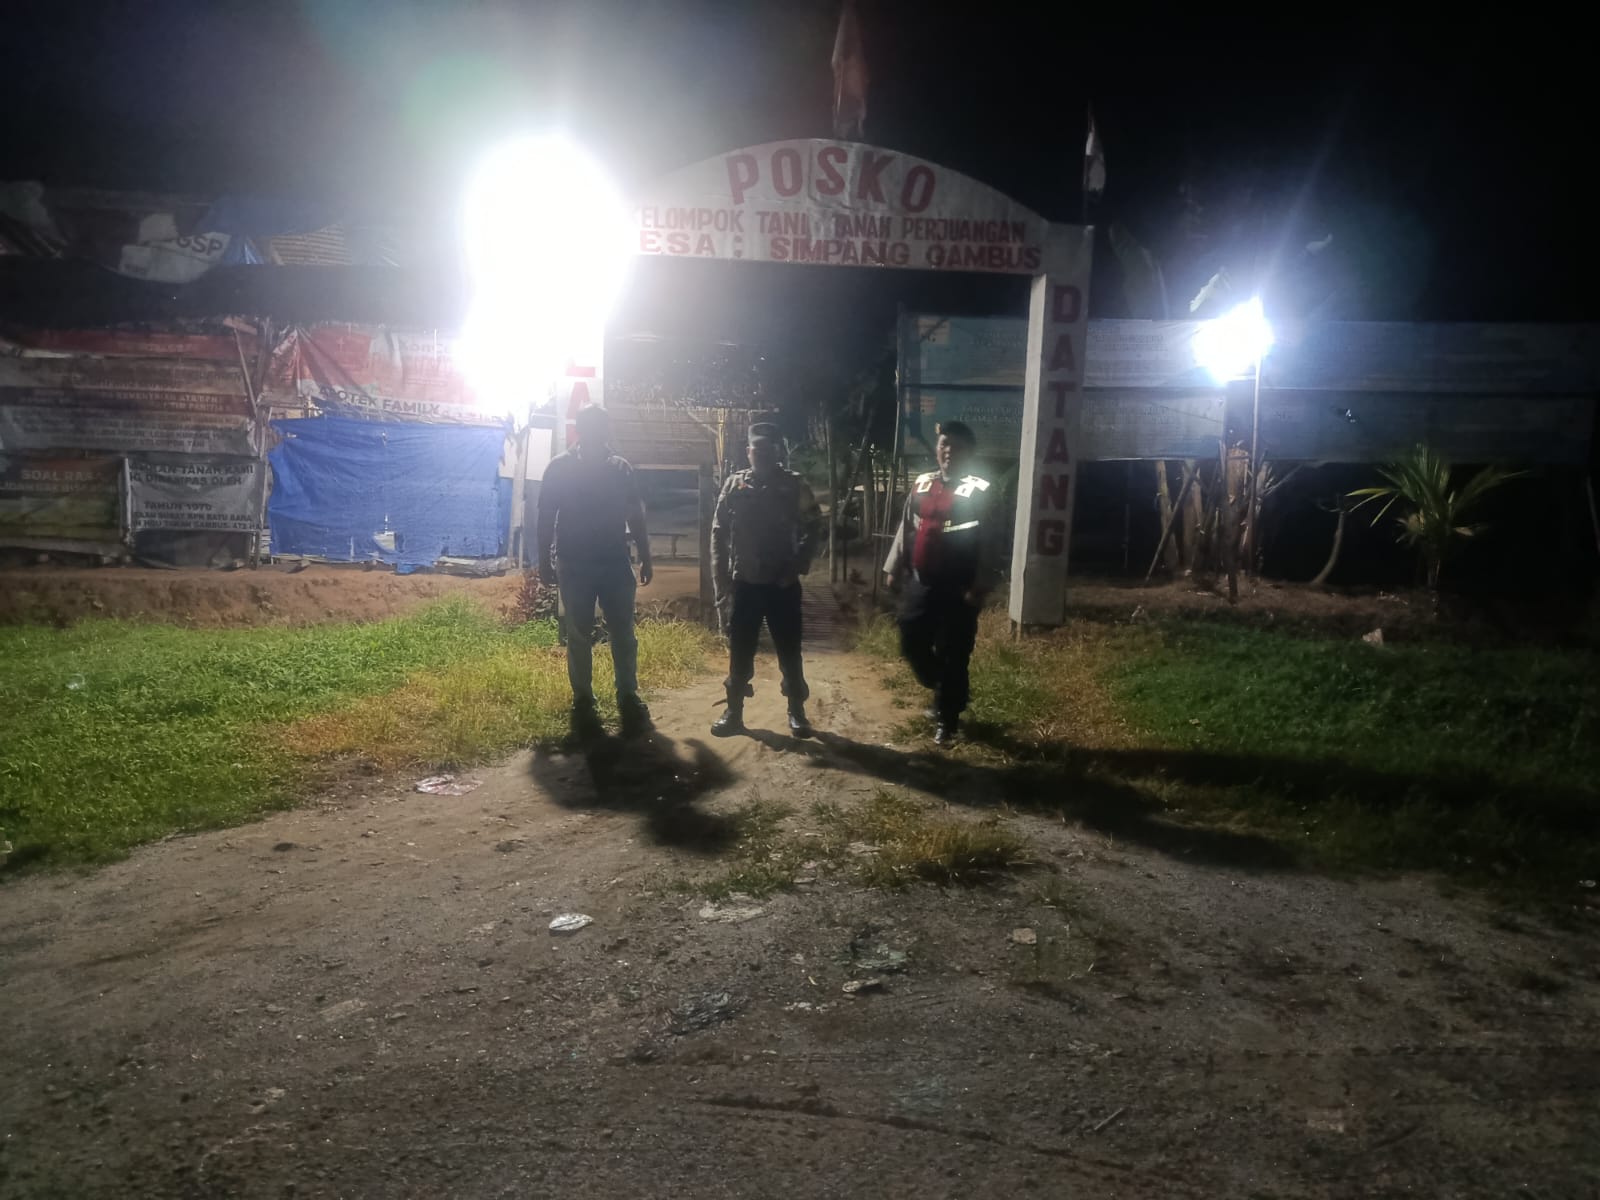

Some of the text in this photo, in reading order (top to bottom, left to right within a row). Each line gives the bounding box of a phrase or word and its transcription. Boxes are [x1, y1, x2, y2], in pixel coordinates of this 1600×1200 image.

[726, 147, 936, 213] POSKO
[638, 205, 744, 233] ELOMPOK
[756, 211, 812, 235] TANI
[903, 217, 1027, 244] PERJUANGAN
[639, 230, 716, 256] ESA
[769, 236, 911, 266] SIMPANG
[382, 399, 440, 416] FAMILY
[1036, 285, 1082, 556] DATANG
